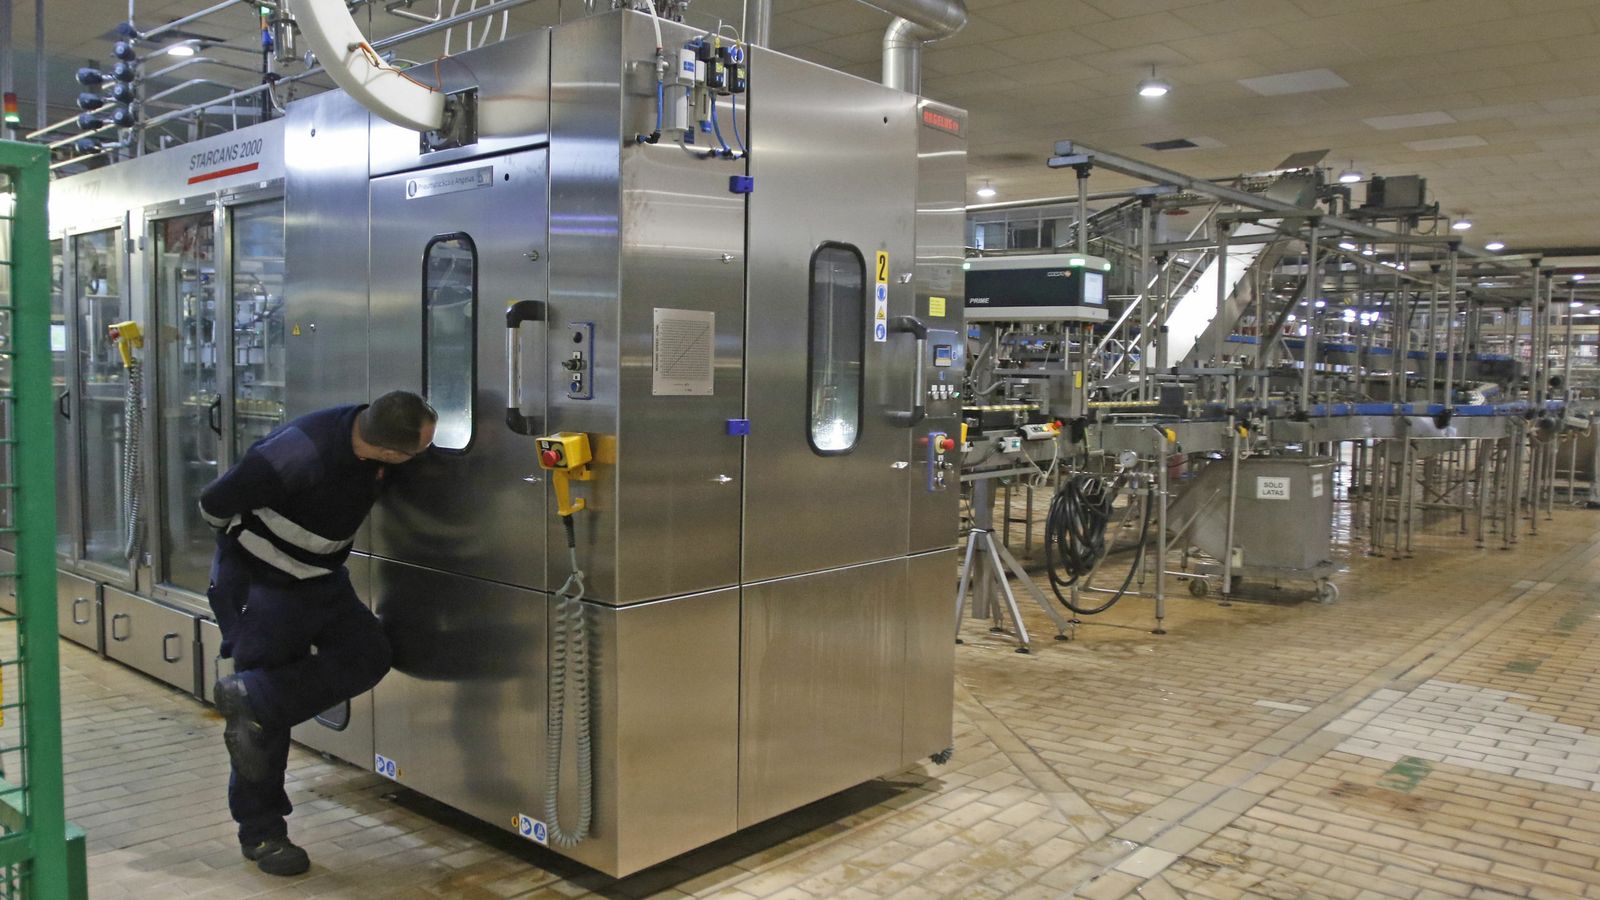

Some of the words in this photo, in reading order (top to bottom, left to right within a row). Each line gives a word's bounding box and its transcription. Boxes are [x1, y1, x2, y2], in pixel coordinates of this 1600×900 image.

[189, 144, 239, 170] STARCANS
[240, 138, 263, 158] 2000
[879, 254, 886, 281] 2
